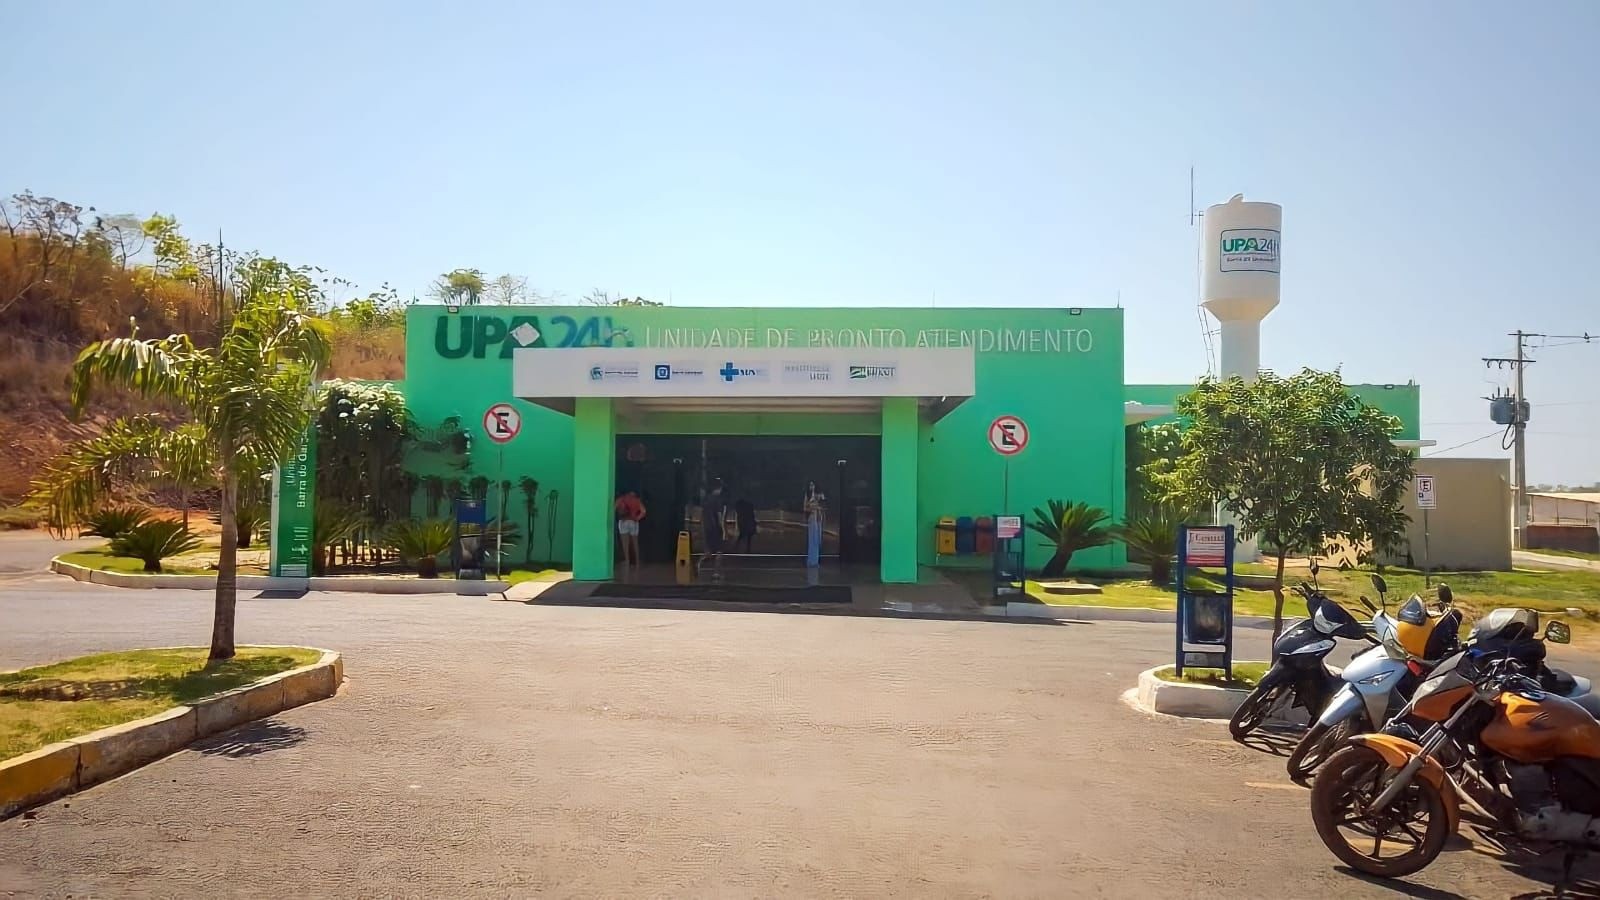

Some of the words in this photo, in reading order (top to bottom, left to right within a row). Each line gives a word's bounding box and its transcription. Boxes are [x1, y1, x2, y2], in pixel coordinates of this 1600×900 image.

[1223, 238, 1258, 252] UPA
[435, 315, 547, 359] UPA
[645, 326, 755, 348] UNIDADE
[767, 327, 796, 348] DE
[808, 327, 906, 348] PRONTO
[916, 327, 1094, 353] ATENDIMENTO
[298, 464, 307, 477] do
[296, 480, 307, 508] Barra
